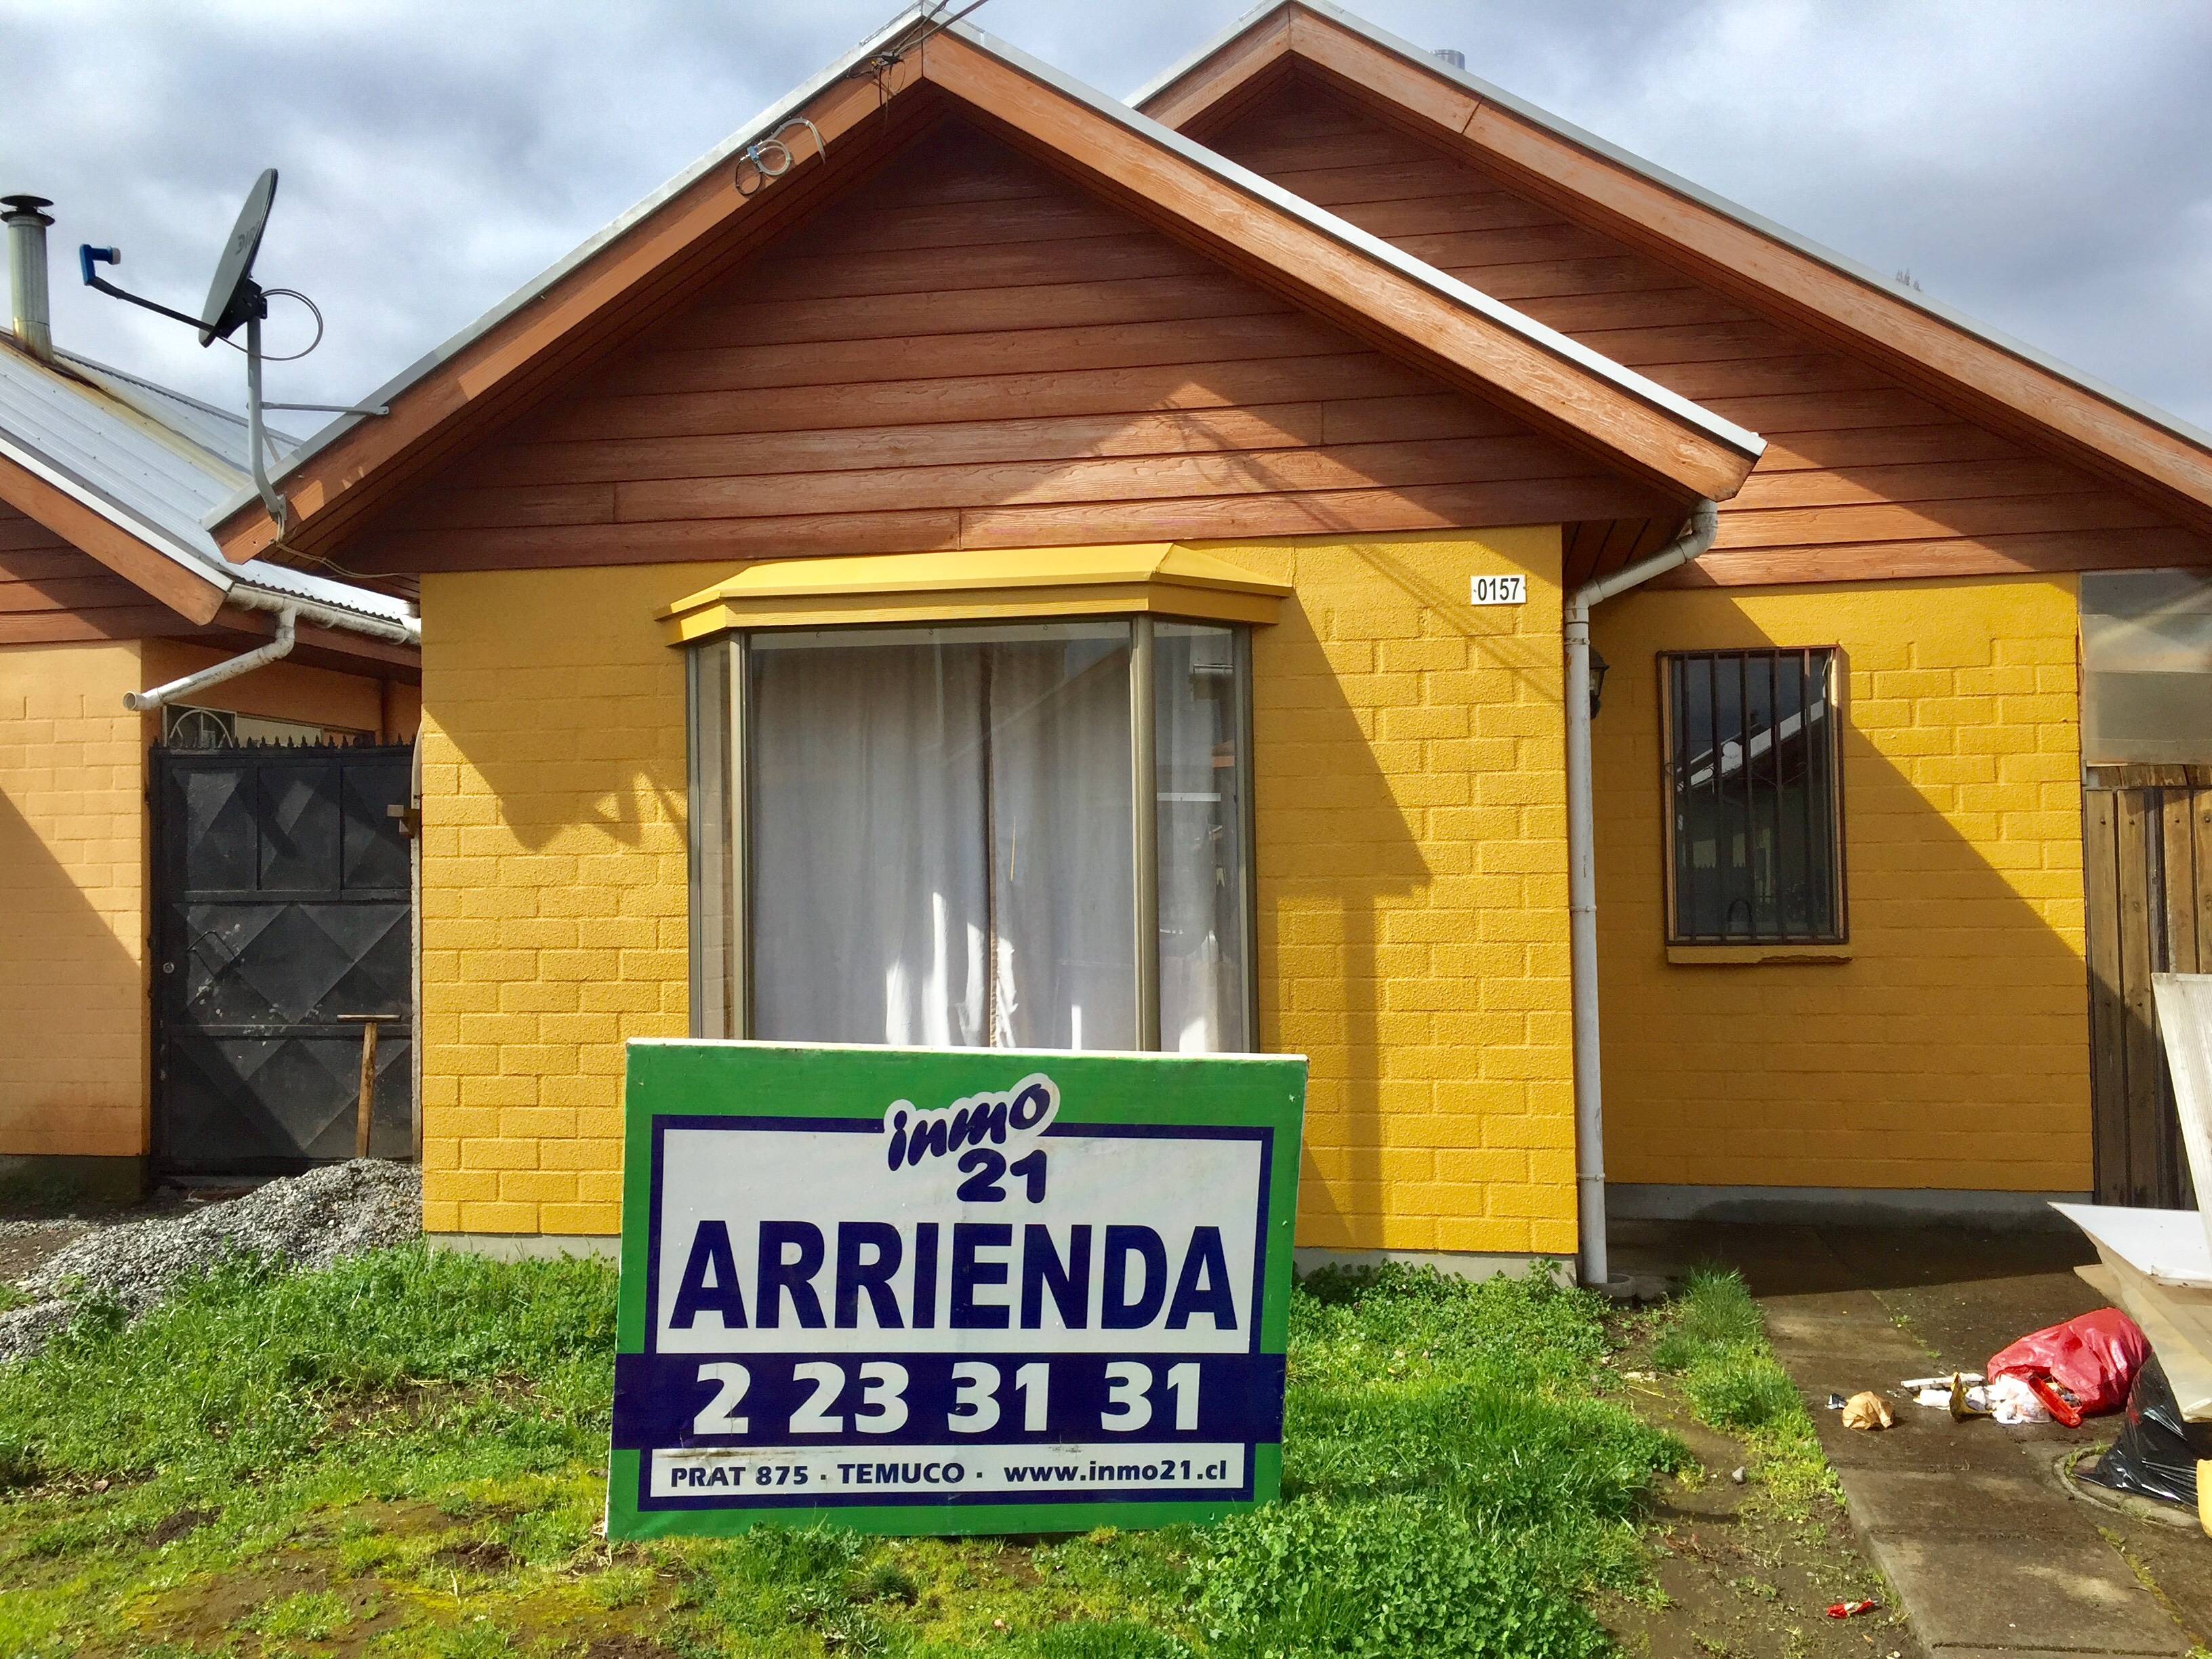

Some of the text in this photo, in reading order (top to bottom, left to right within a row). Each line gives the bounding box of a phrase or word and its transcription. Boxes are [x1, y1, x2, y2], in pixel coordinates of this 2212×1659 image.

[1477, 577, 1520, 601] 0157
[887, 1082, 1051, 1172] inmo
[956, 1147, 1048, 1204] 21
[668, 1220, 1239, 1330] ARRIENDA
[693, 1361, 1202, 1435] 2 23 31 31
[670, 1459, 1227, 1488] PRAT 875 TEMUCO www.inmo21.cl
